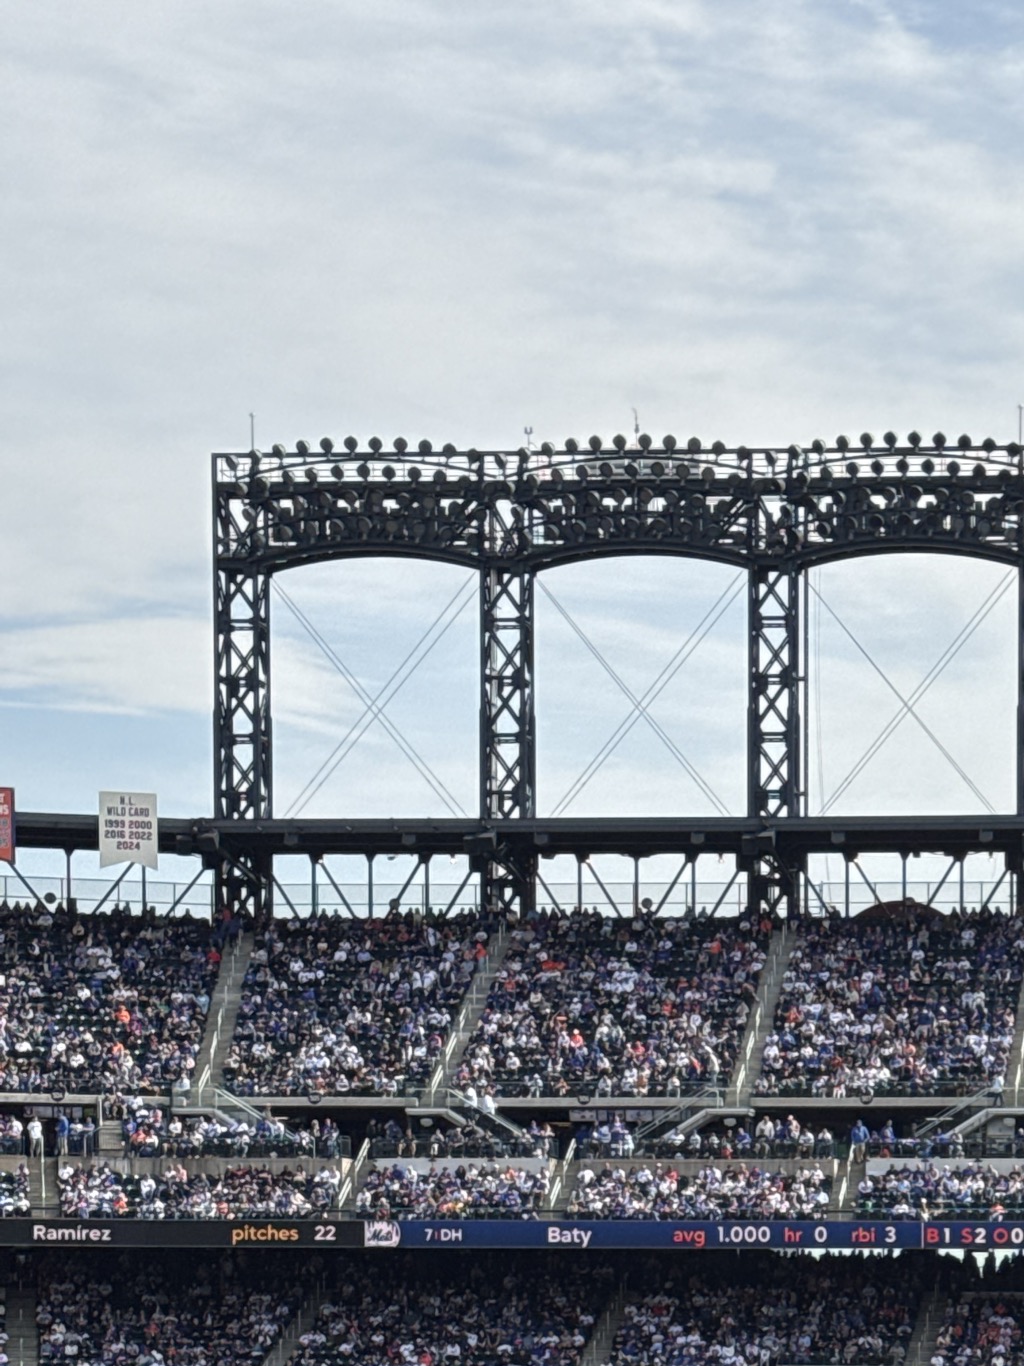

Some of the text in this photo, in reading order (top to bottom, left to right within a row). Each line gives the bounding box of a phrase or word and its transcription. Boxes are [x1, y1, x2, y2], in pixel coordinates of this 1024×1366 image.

[107, 806, 150, 818] WILD CARD
[105, 819, 153, 830] 1999 2000
[129, 831, 153, 841] 2022
[117, 841, 141, 851] 2024
[33, 1224, 112, 1241] Ramírez
[232, 1225, 337, 1246] pitches 22
[425, 1228, 463, 1241] 7 DH
[547, 1226, 593, 1247] Baty
[673, 1226, 897, 1248] avg 1.000 hr 0 rbi 3
